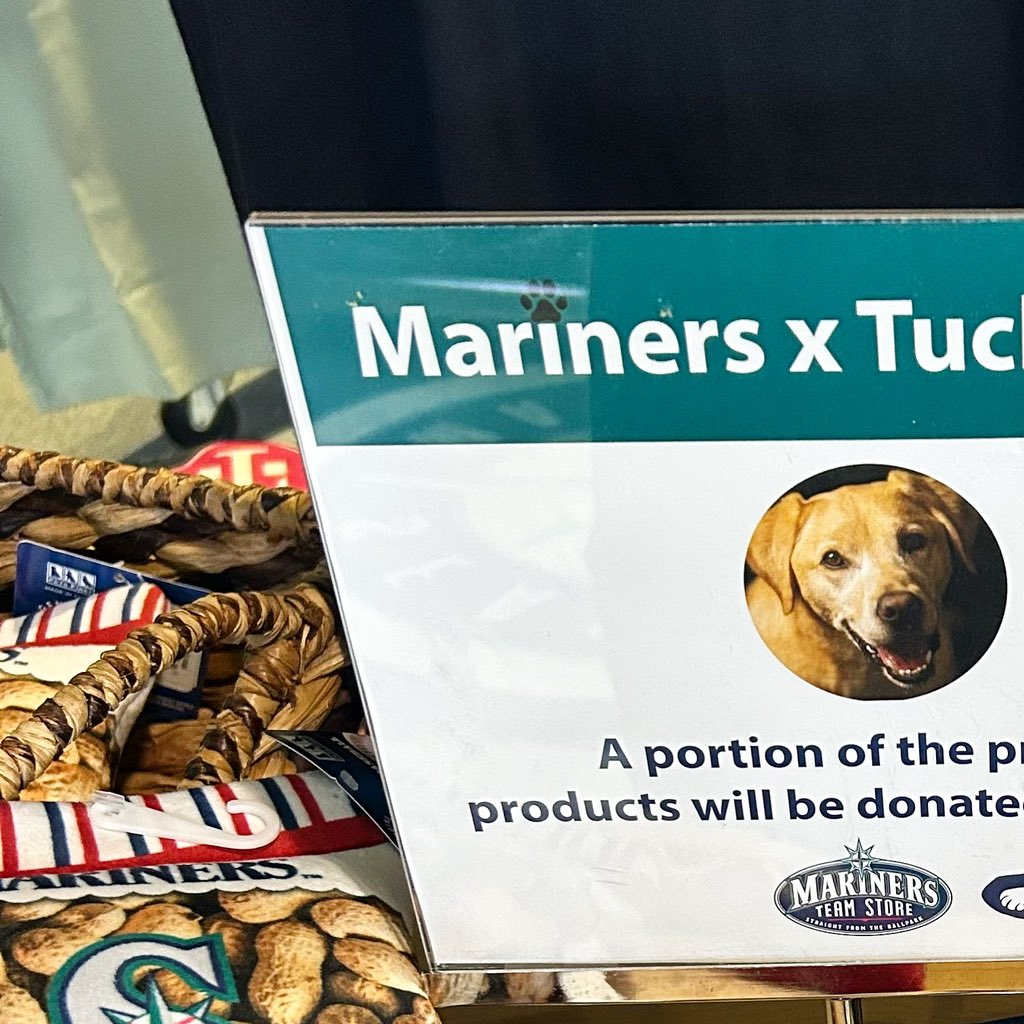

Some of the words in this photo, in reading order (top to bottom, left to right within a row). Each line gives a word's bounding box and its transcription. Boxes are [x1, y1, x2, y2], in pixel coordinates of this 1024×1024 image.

[351, 303, 766, 379] Mariners
[786, 318, 842, 373] x
[599, 737, 633, 770] A
[644, 735, 824, 777] portion
[837, 733, 885, 768] of
[897, 732, 974, 766] the
[467, 790, 681, 832] products
[691, 788, 773, 822] will
[788, 788, 844, 821] be
[0, 858, 299, 891] ARINERS
[789, 870, 939, 911] MARINERS
[805, 916, 843, 931] STRAIGHT
[846, 924, 866, 932] FROM
[869, 923, 884, 932] THE
[815, 898, 856, 918] TEAM
[865, 898, 913, 917] STORE
